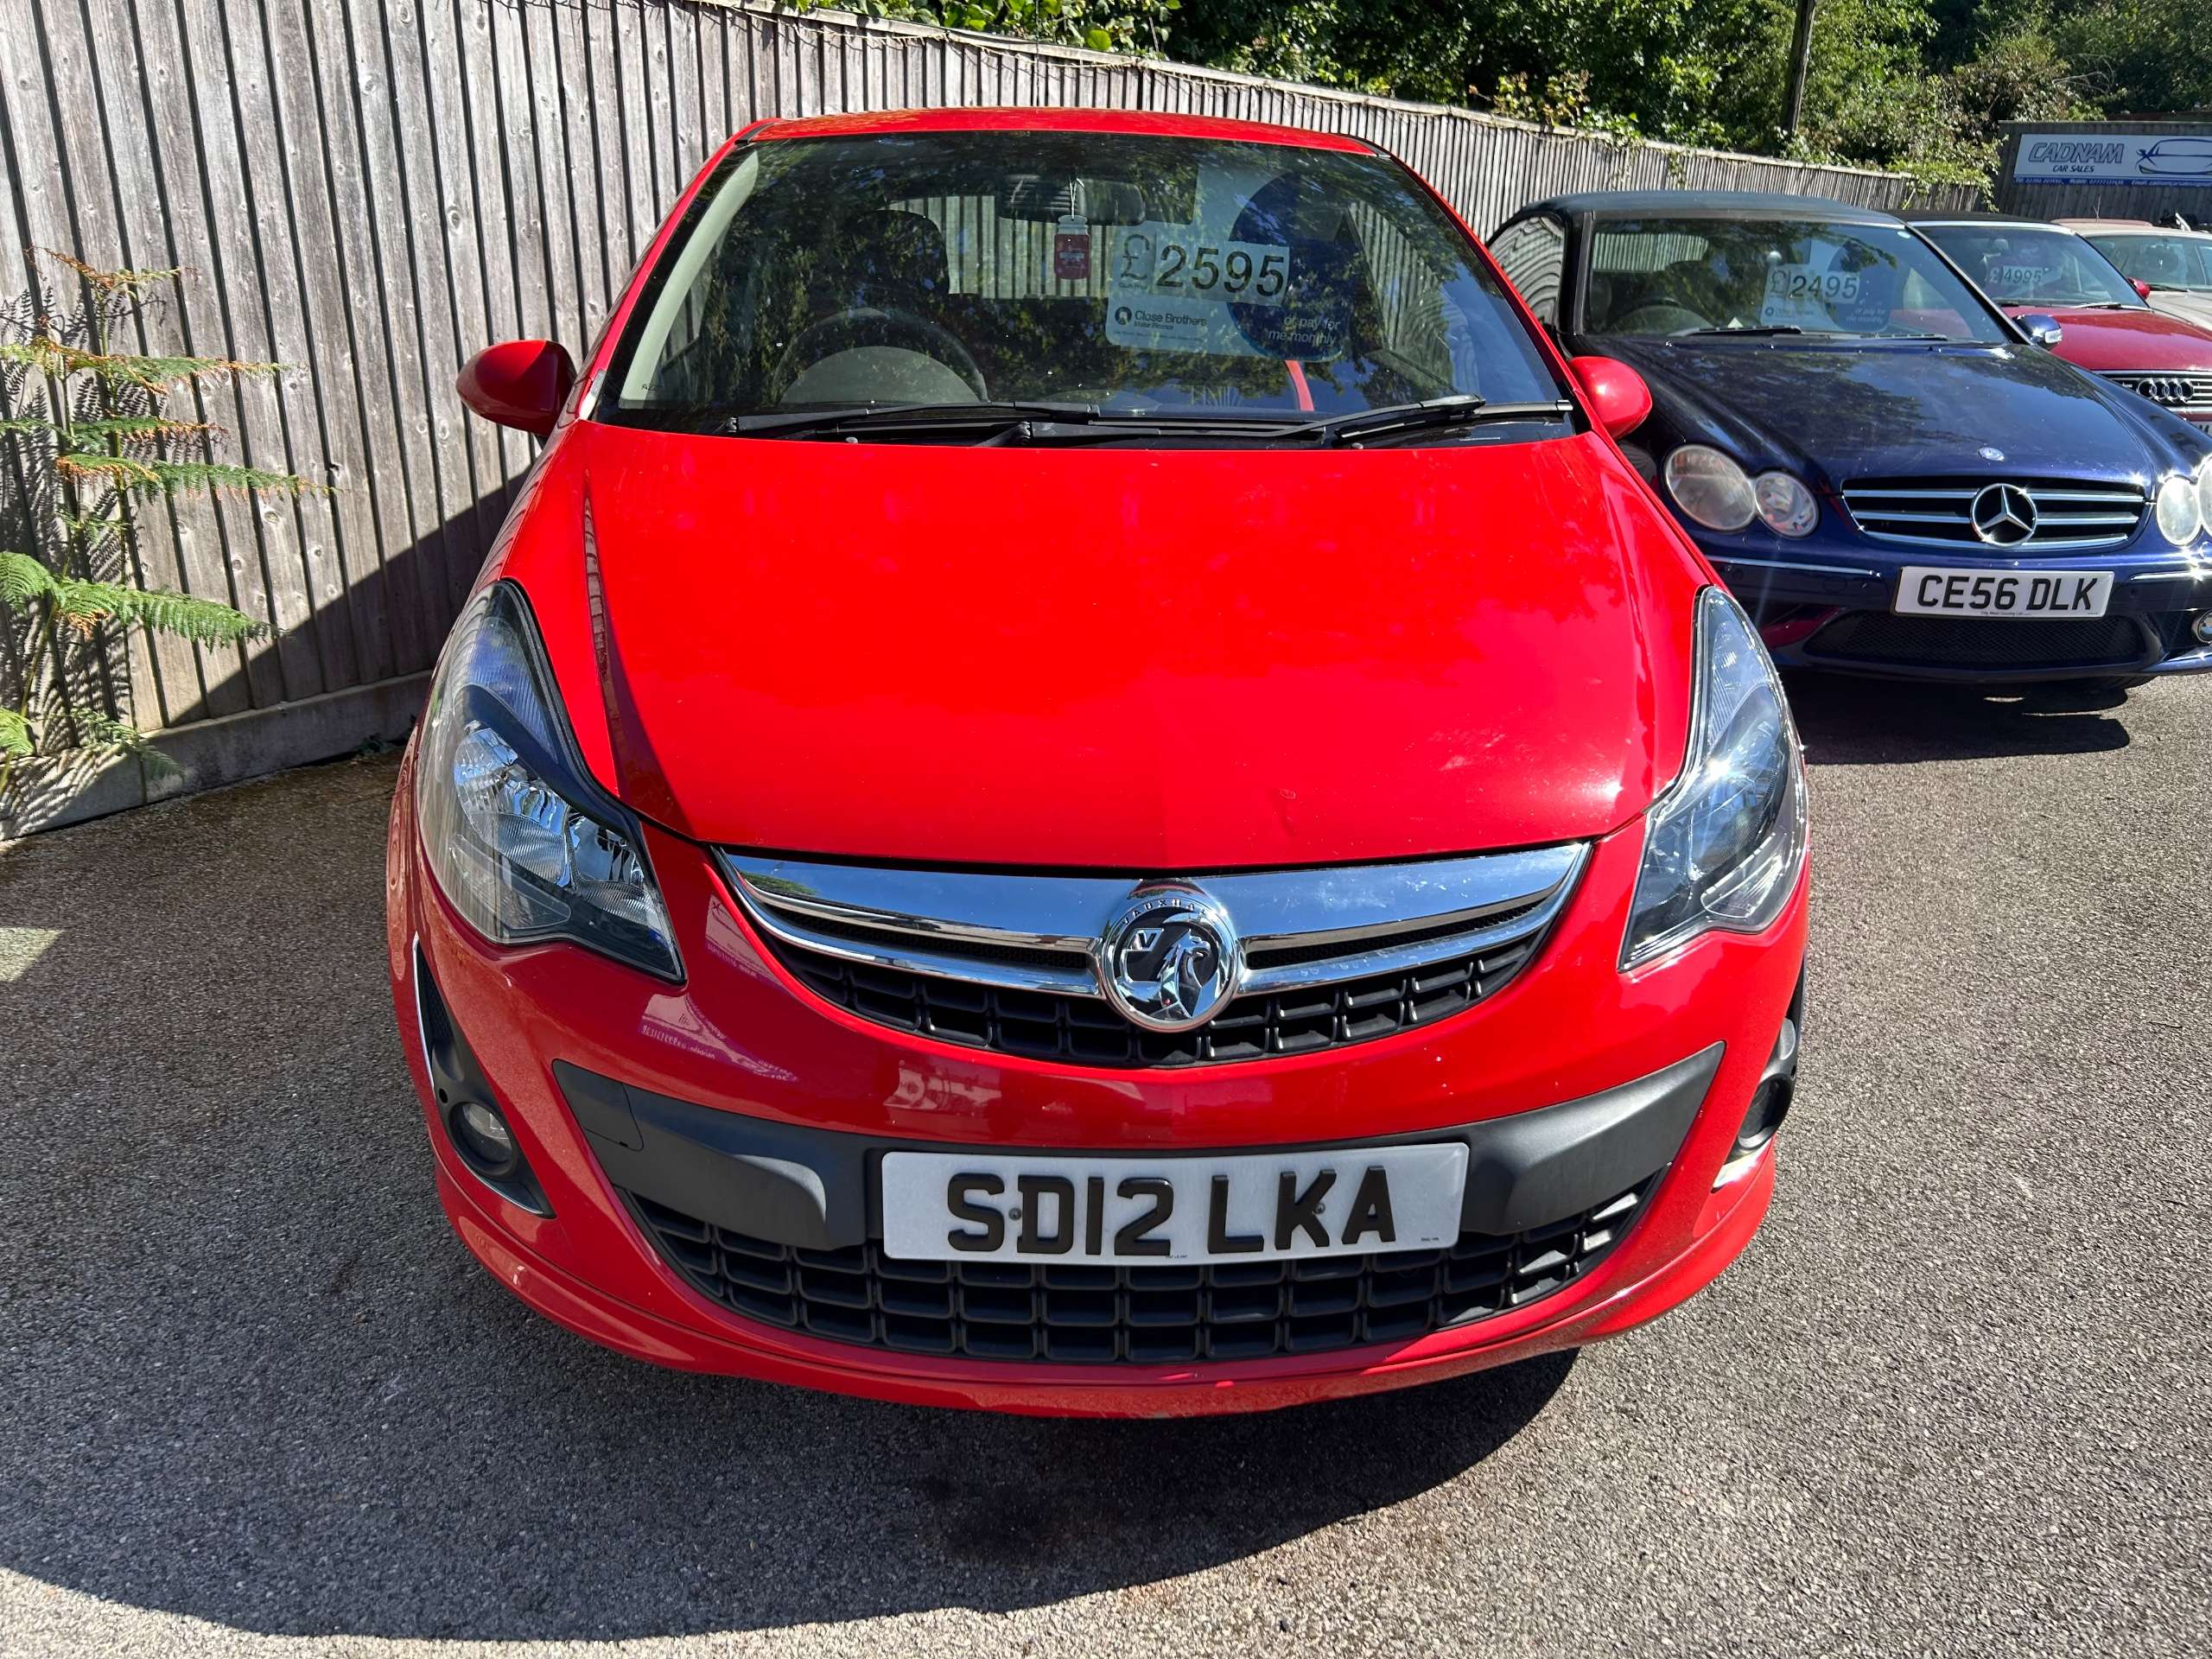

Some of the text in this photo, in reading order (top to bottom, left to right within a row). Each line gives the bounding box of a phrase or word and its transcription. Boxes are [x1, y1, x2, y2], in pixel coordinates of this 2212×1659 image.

[2028, 142, 2125, 164] CADNAM
[2070, 165, 2094, 174] SALES
[1120, 233, 1285, 296] £2595
[1770, 270, 1858, 299] £2495
[1135, 310, 1208, 327] Close Brothers
[1298, 317, 1320, 330] pay
[1916, 575, 2098, 611] CE56 DLK
[948, 1165, 1396, 1256] SD12 LKA
